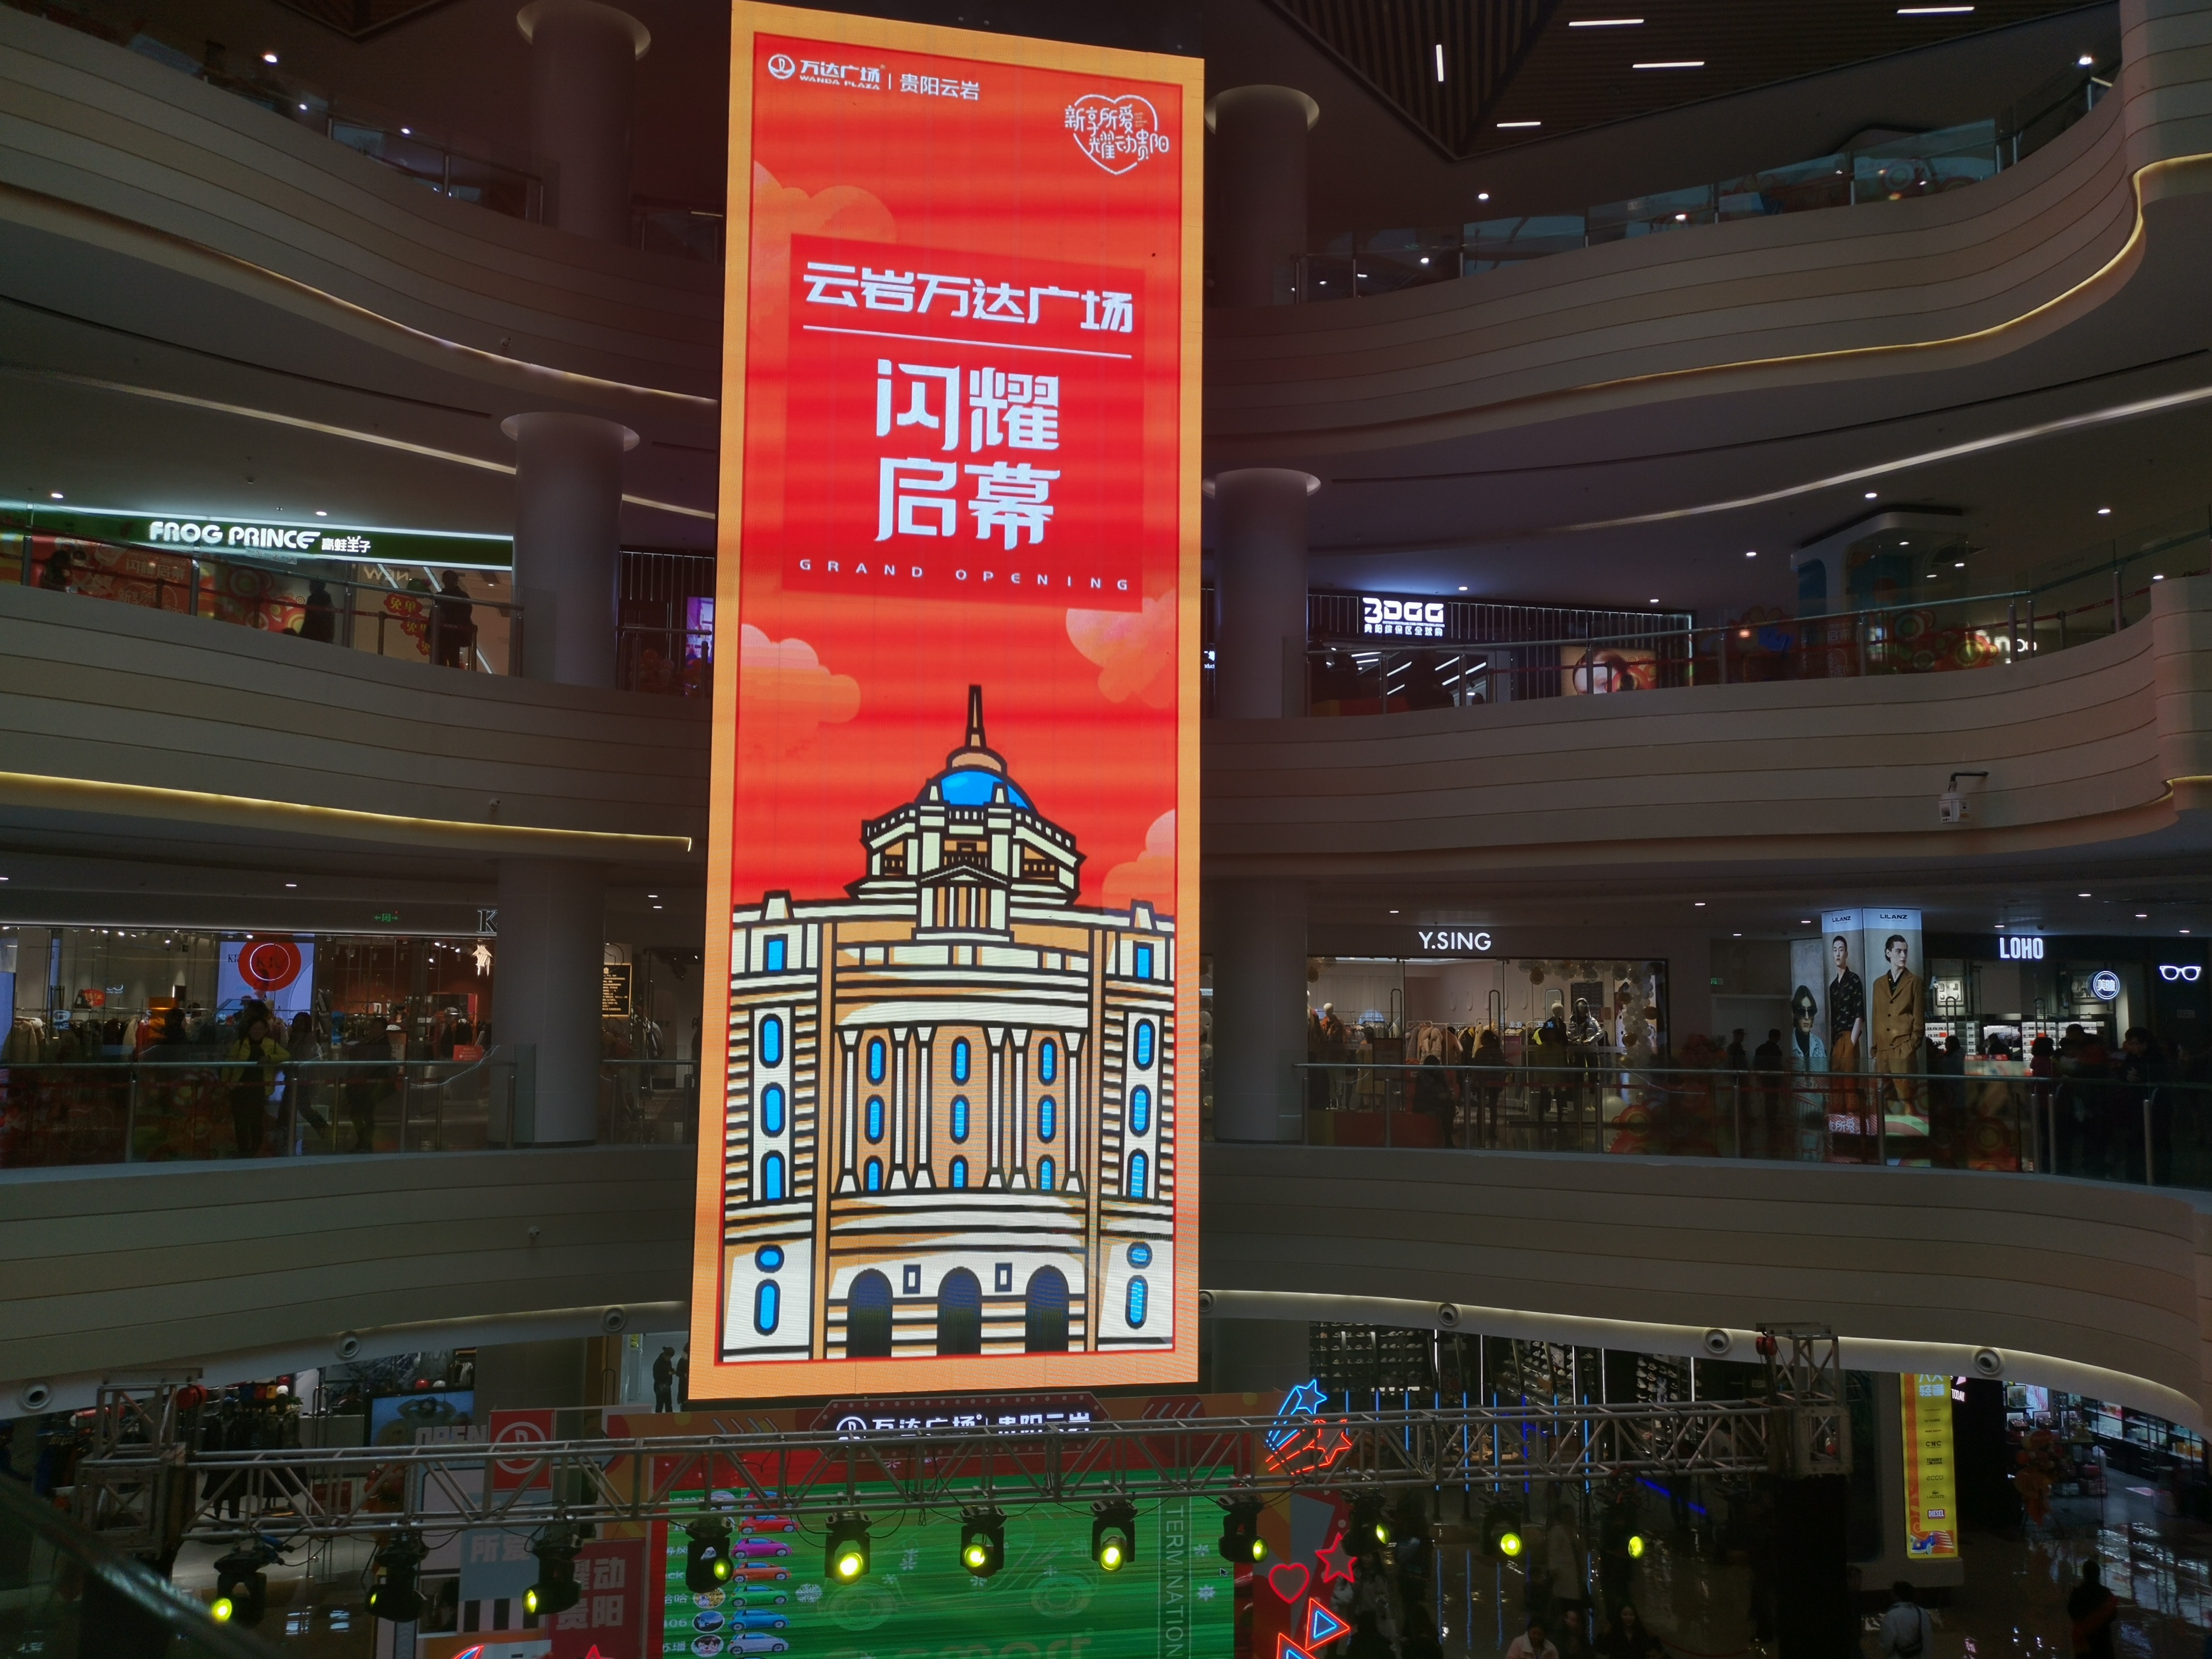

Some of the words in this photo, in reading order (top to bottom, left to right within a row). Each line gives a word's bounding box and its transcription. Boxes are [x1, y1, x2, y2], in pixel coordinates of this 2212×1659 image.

[799, 75, 840, 85] WANDA
[844, 80, 880, 90] PLAZA
[800, 59, 880, 83] 万达广场
[900, 73, 980, 100] 贵阳云岩
[1089, 129, 1170, 161] 耀动贵阳
[803, 262, 1132, 333] 云岩万达广场
[876, 358, 1059, 452] 闪耀
[874, 457, 1061, 551] 启幕
[150, 521, 223, 544] FROG
[228, 526, 321, 549] PRINCE
[321, 535, 371, 553] 青蛙王子
[799, 559, 923, 578] GRAND
[955, 569, 1128, 591] OPENING
[390, 597, 417, 612] 免单
[1418, 931, 1492, 950] Y.SING
[1999, 937, 2044, 959] LOHO
[2097, 979, 2116, 992] 美瞳
[1919, 1384, 1945, 1396] 轻奢
[1951, 1389, 1965, 1402] TODAY
[1928, 1509, 1945, 1518] DIESEL
[1165, 1506, 1184, 1657] TERMINATION
